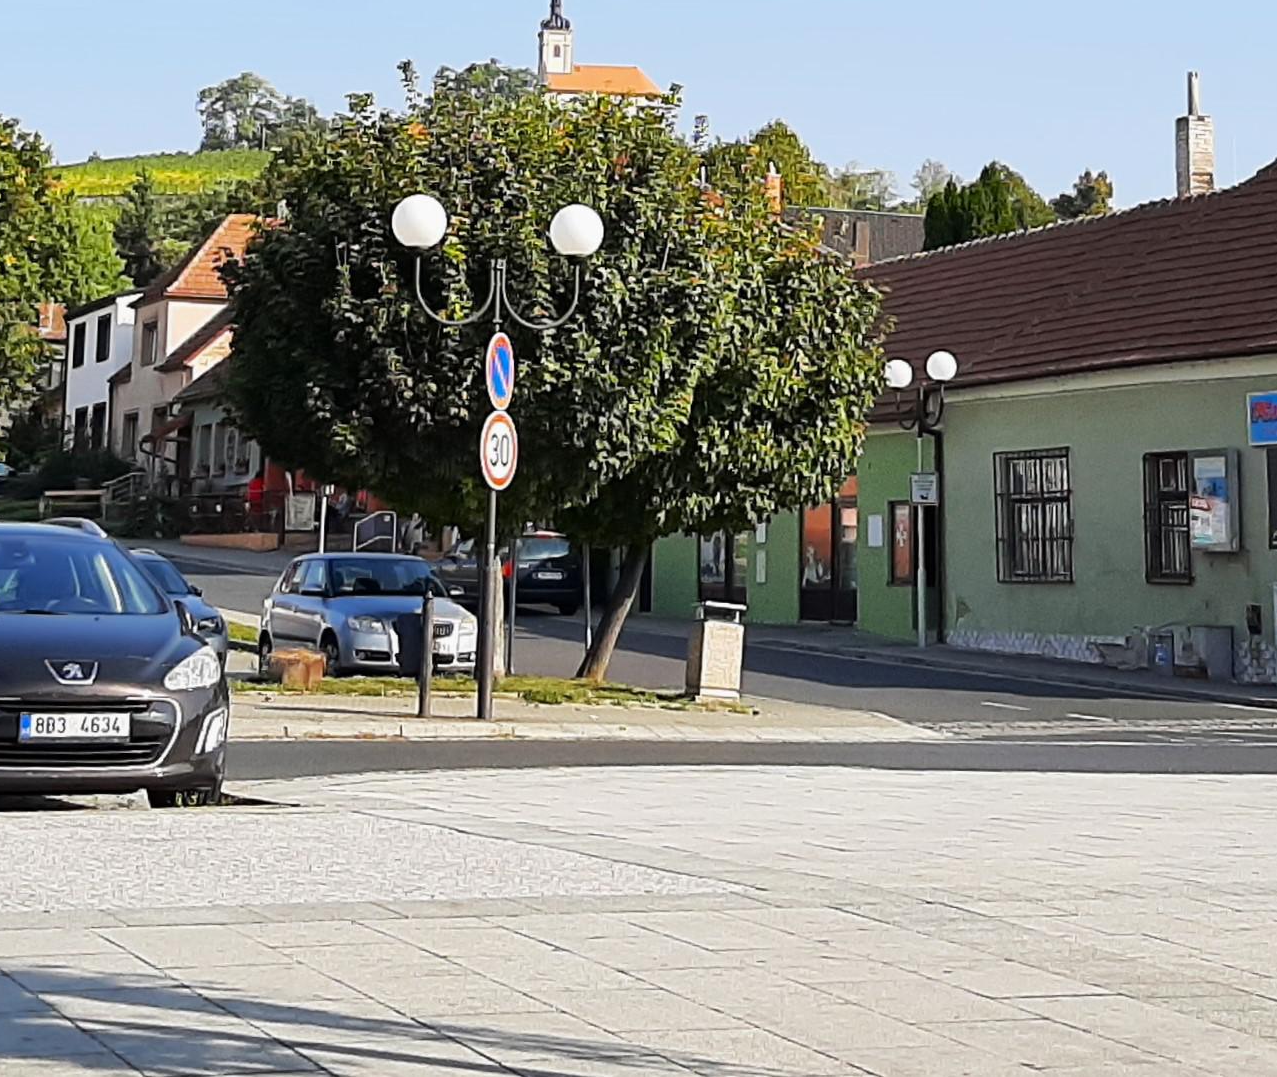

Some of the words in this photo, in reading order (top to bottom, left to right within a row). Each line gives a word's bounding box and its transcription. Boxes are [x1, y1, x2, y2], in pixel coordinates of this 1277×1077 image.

[490, 433, 509, 467] 30
[35, 716, 66, 734] 8B3
[80, 716, 120, 734] 4634
